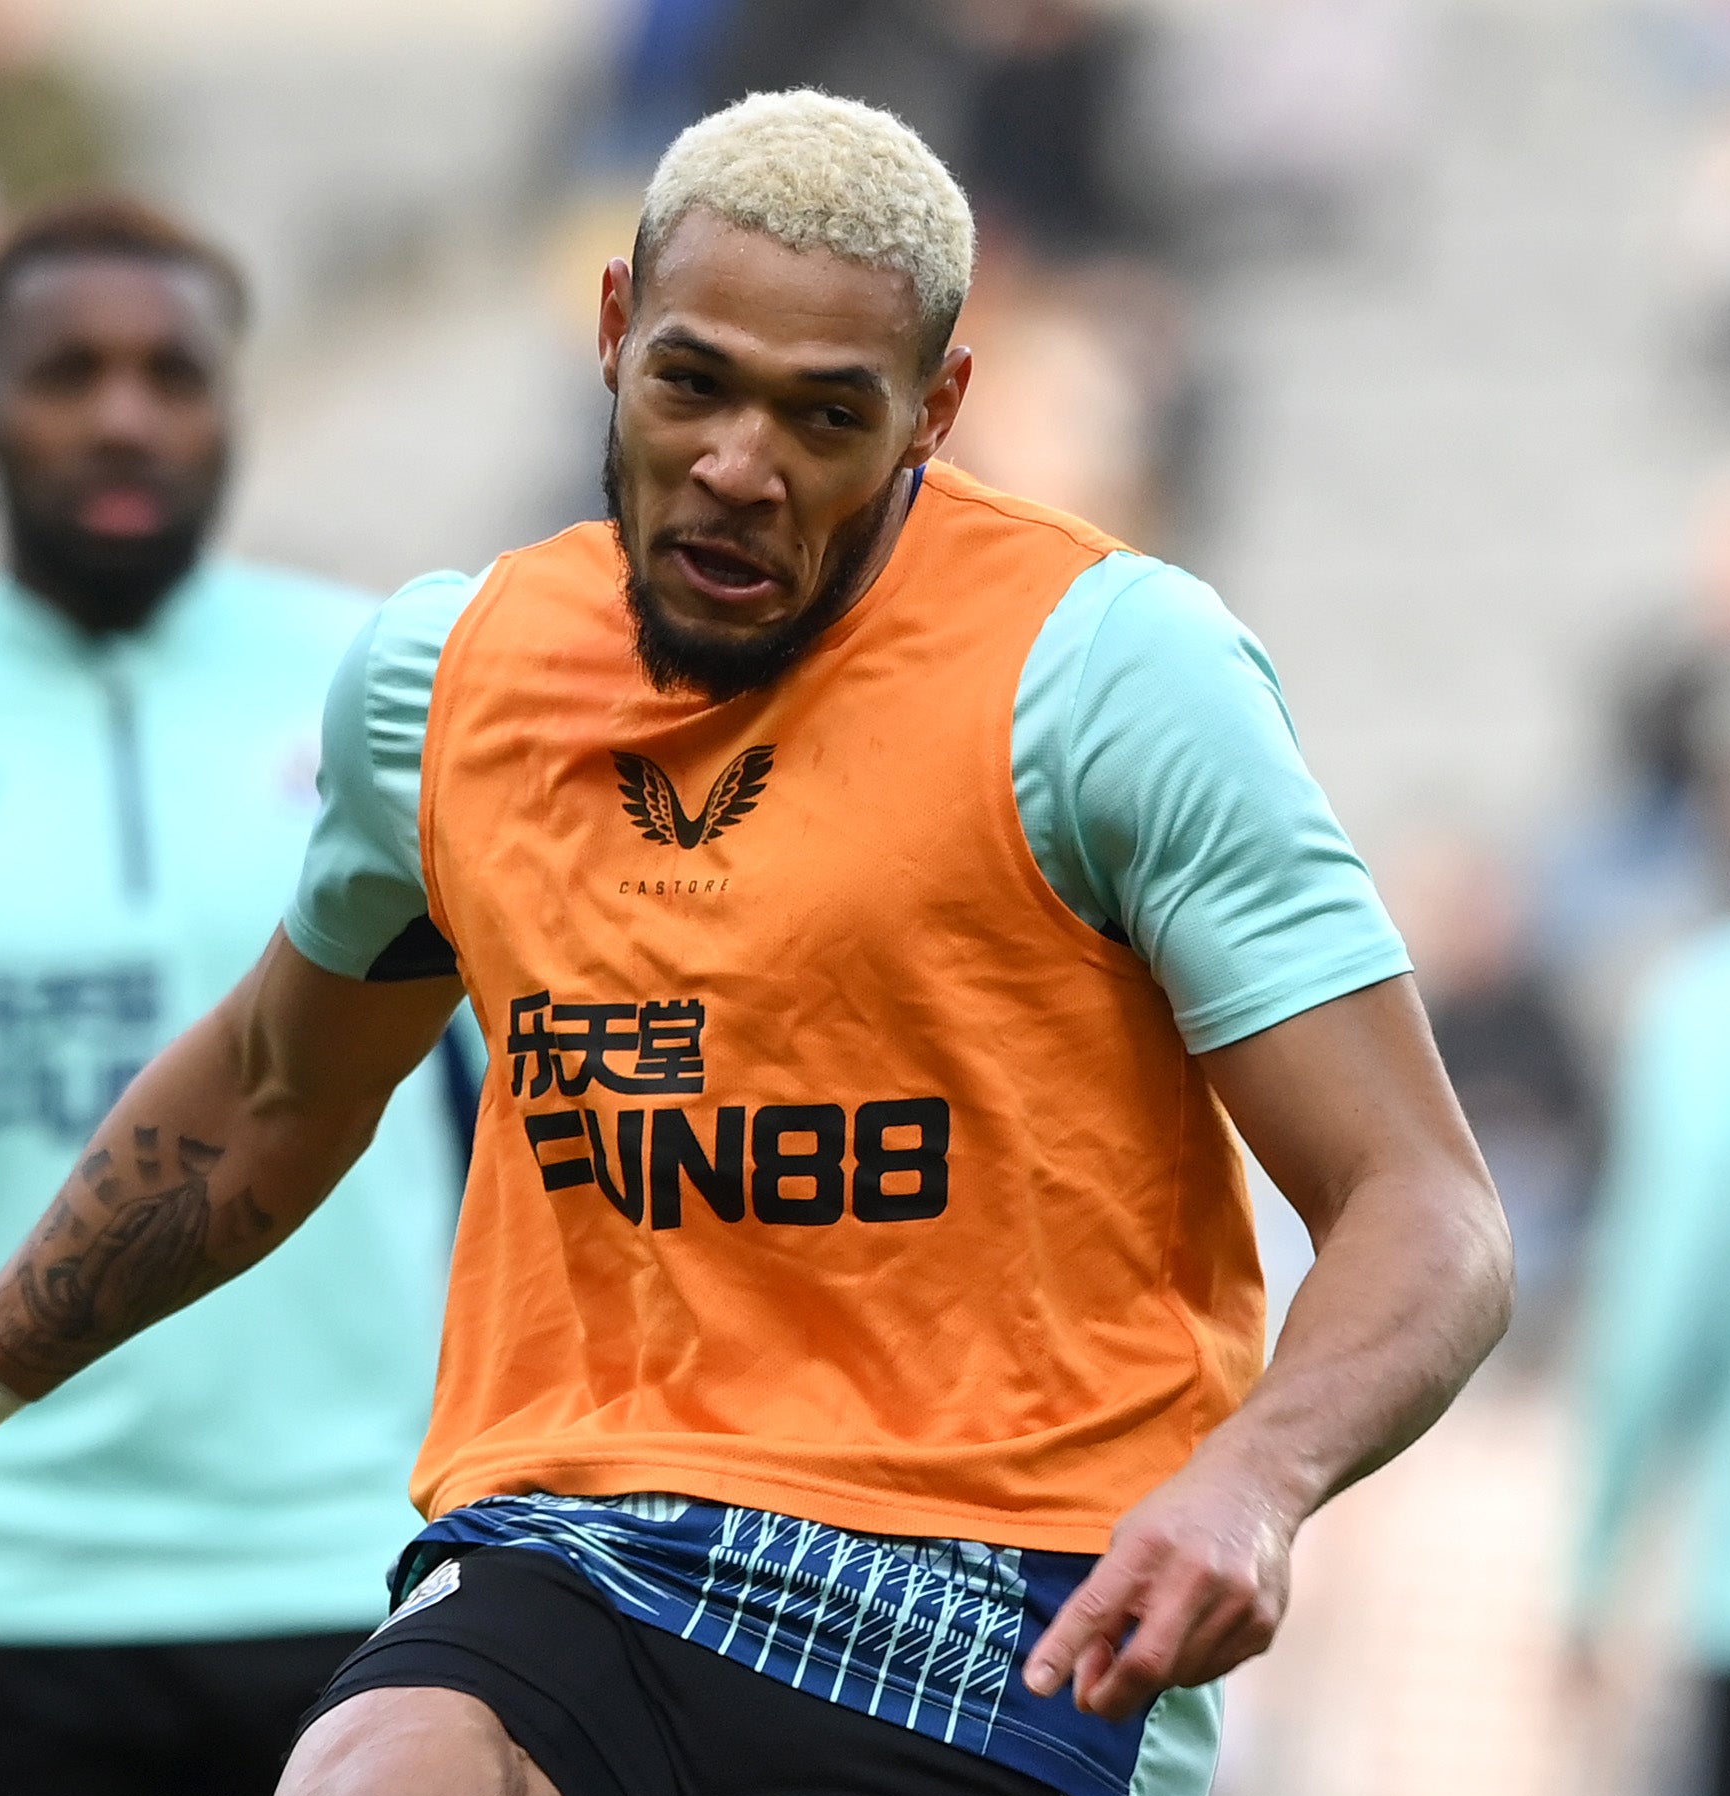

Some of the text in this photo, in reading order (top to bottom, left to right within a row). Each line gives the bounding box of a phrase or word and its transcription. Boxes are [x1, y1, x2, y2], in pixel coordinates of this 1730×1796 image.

[618, 878, 730, 896] CASTORE
[507, 990, 705, 1099] 乐天堂
[524, 1097, 950, 1230] FUN88
